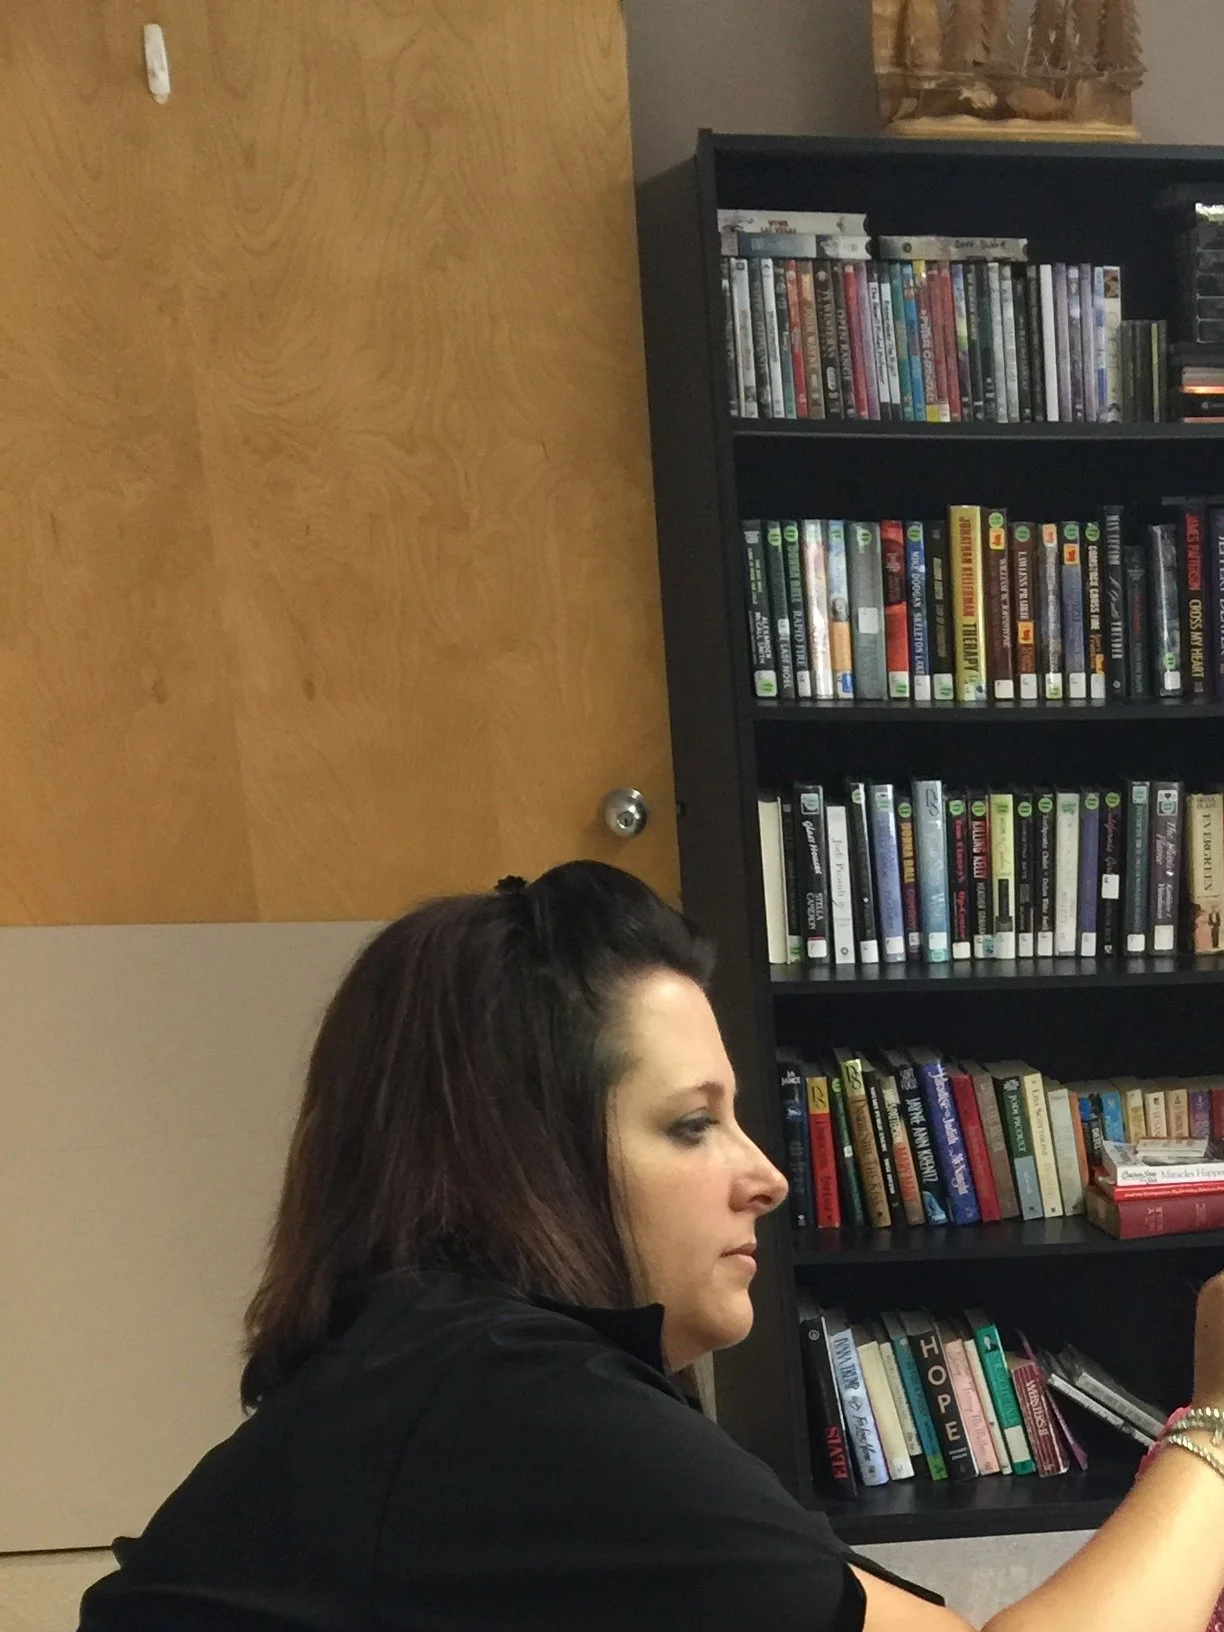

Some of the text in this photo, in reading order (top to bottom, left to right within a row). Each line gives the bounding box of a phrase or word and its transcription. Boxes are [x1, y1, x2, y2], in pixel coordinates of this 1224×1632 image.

[959, 516, 976, 618] JONATHAN KELLERMAN
[1187, 514, 1202, 591] JAMES PATTERSON
[795, 643, 807, 669] FIRE
[962, 623, 979, 673] THERAPY
[1189, 599, 1205, 678] CROSS MY HEART
[972, 855, 989, 880] KELLY
[1202, 813, 1214, 892] EVERGREEN
[904, 1097, 922, 1125] JAYNE
[1007, 1094, 1020, 1116] JODI
[911, 1127, 929, 1148] ANN
[1009, 1115, 1028, 1153] PICOULT
[916, 1149, 939, 1184] KRENTZ
[1160, 1168, 1195, 1183] Miracles
[840, 1363, 861, 1391] TRUMP
[920, 1335, 961, 1442] HOPE
[826, 1427, 849, 1479] ELVIS
